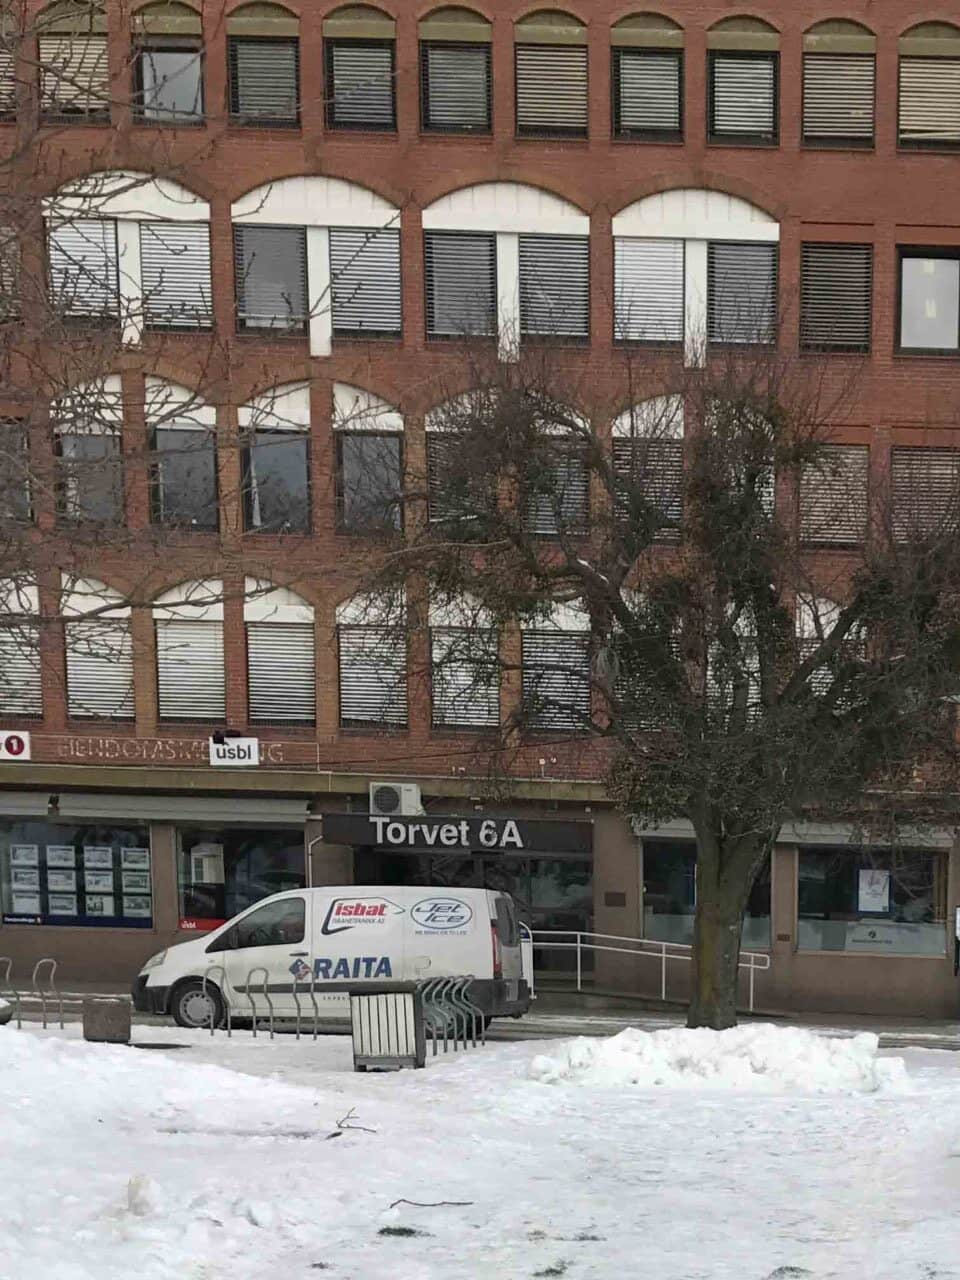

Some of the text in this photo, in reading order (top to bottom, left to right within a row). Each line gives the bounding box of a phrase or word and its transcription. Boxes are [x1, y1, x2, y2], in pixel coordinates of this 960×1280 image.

[369, 816, 525, 849] Torvet 6A
[335, 902, 388, 917] isbat
[415, 903, 461, 913] Jet
[314, 957, 393, 979] RAITA
